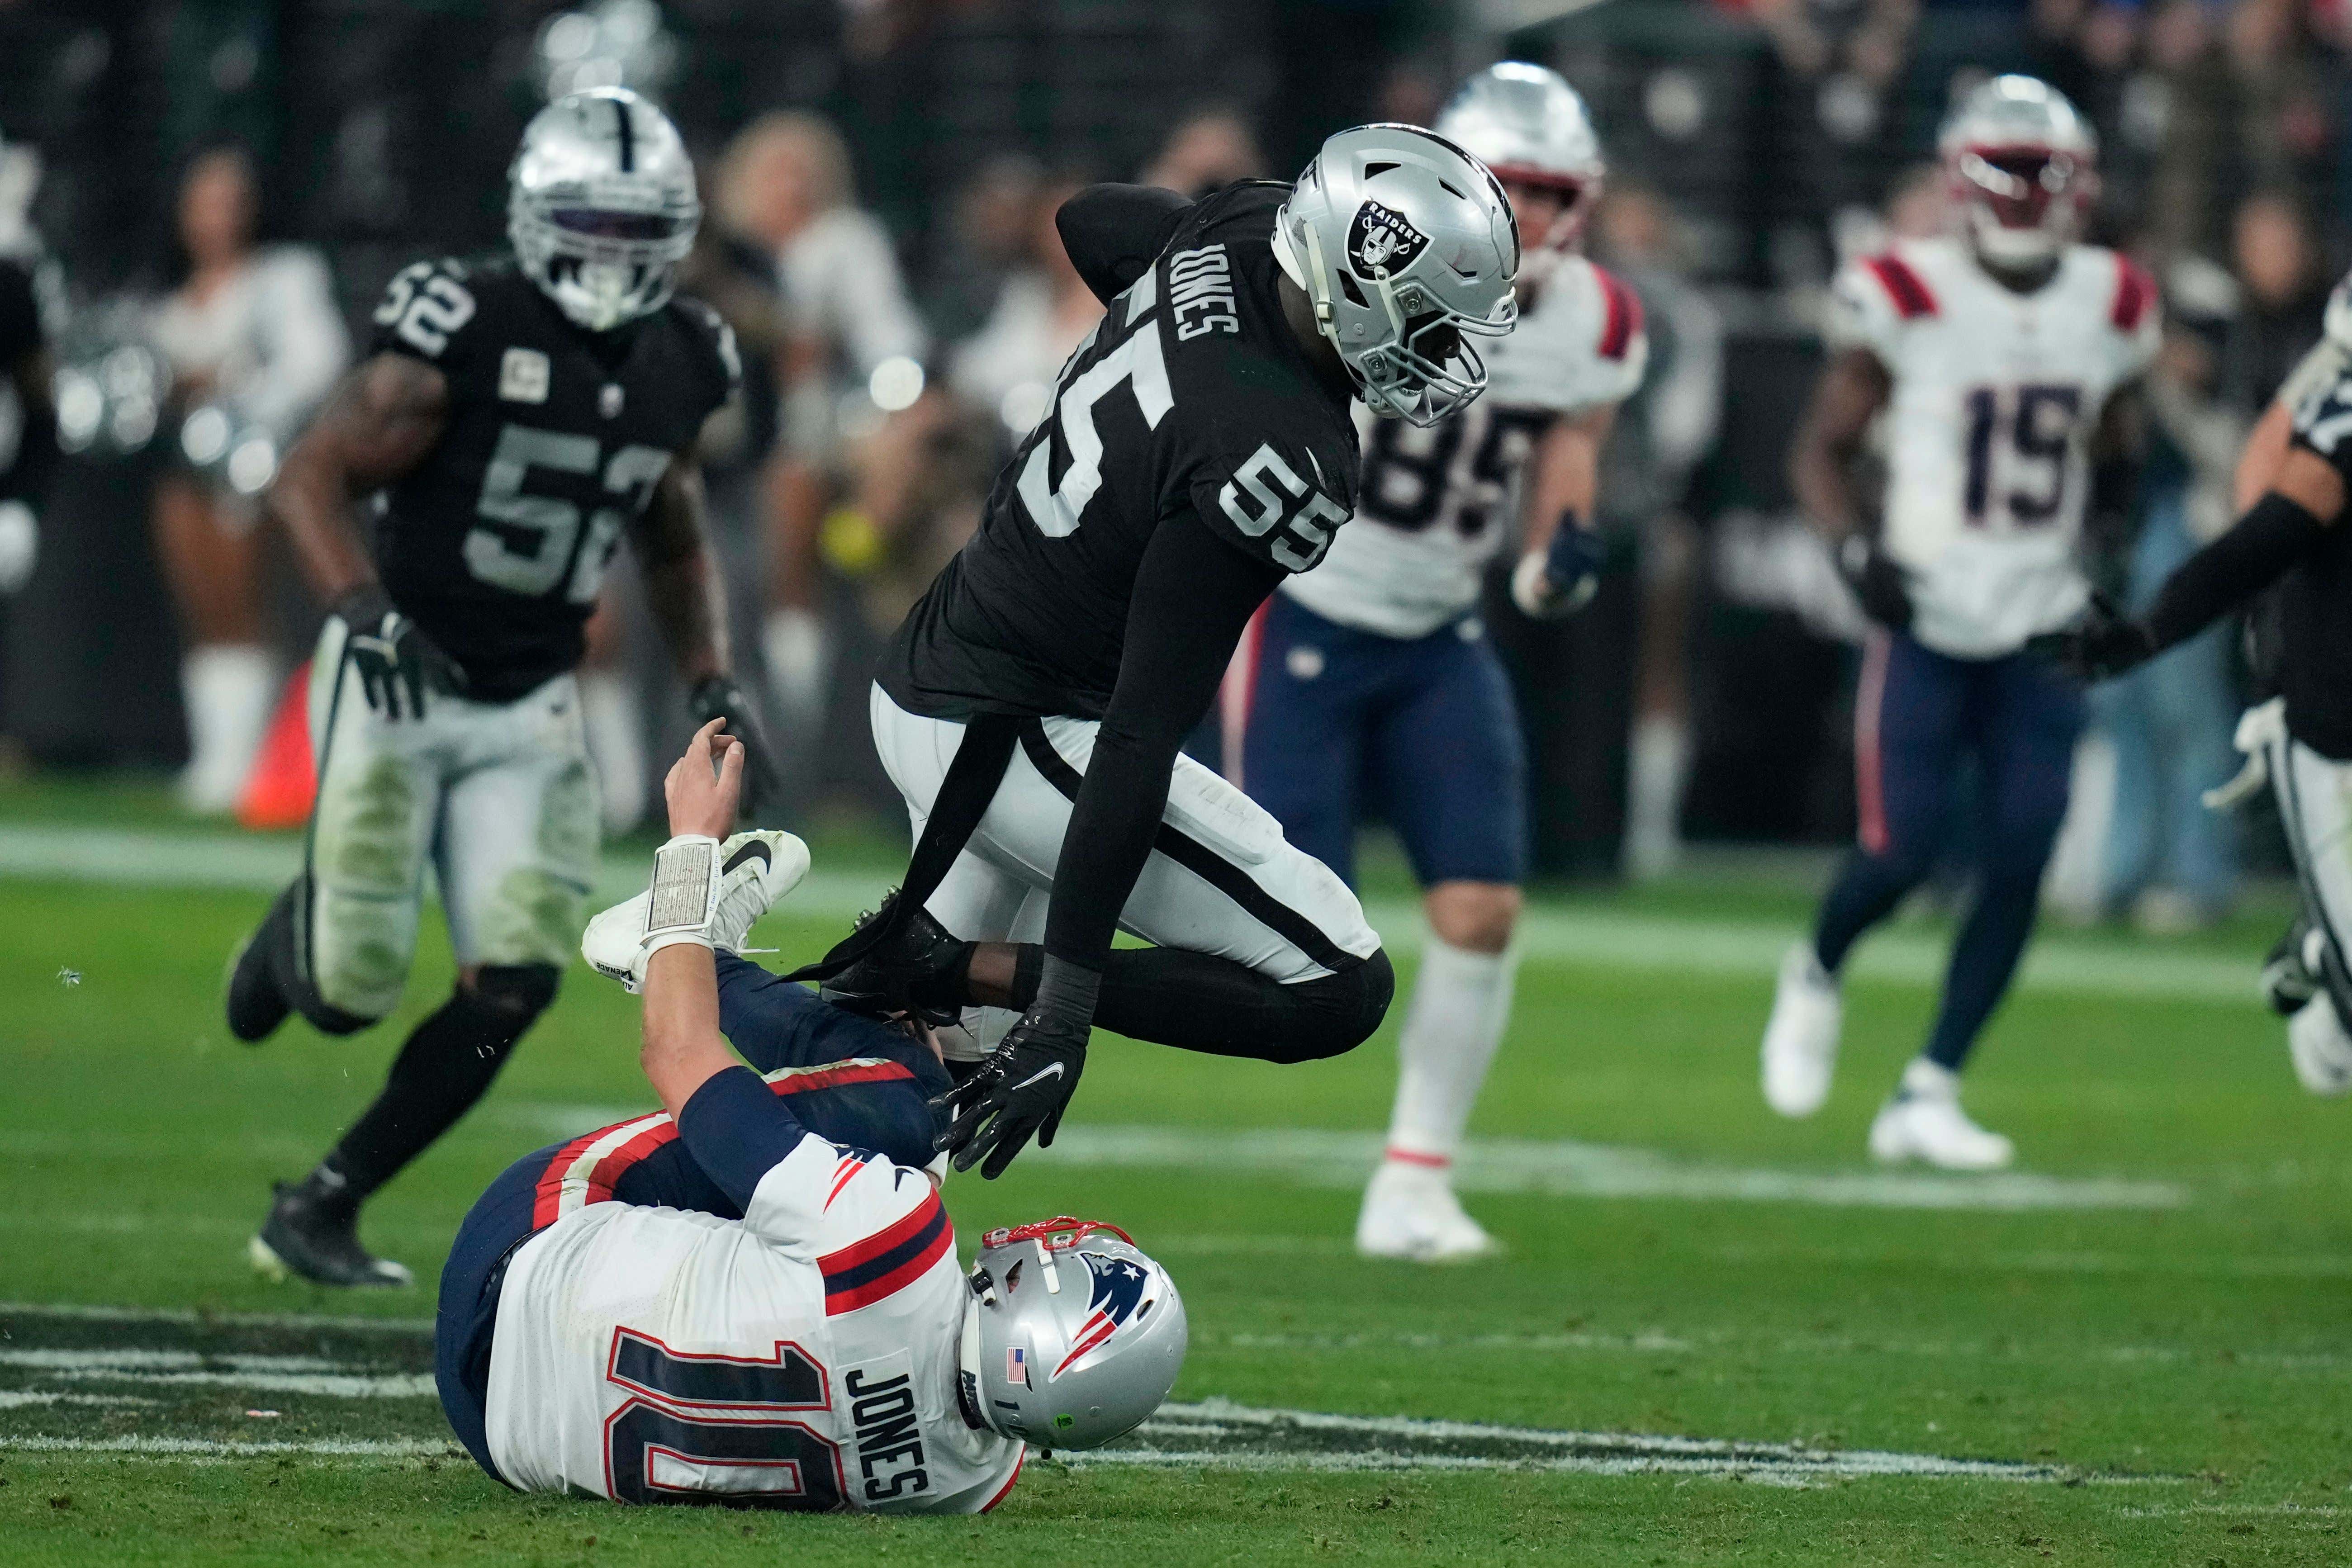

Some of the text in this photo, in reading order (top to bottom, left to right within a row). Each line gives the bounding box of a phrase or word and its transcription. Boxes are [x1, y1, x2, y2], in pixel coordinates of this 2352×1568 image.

[1368, 202, 1423, 245] RAIDERS
[374, 261, 475, 356] 52
[1170, 243, 1239, 341] JONES
[1219, 443, 1349, 572] 55
[604, 1325, 847, 1510] 10
[845, 1369, 929, 1500] JONES
